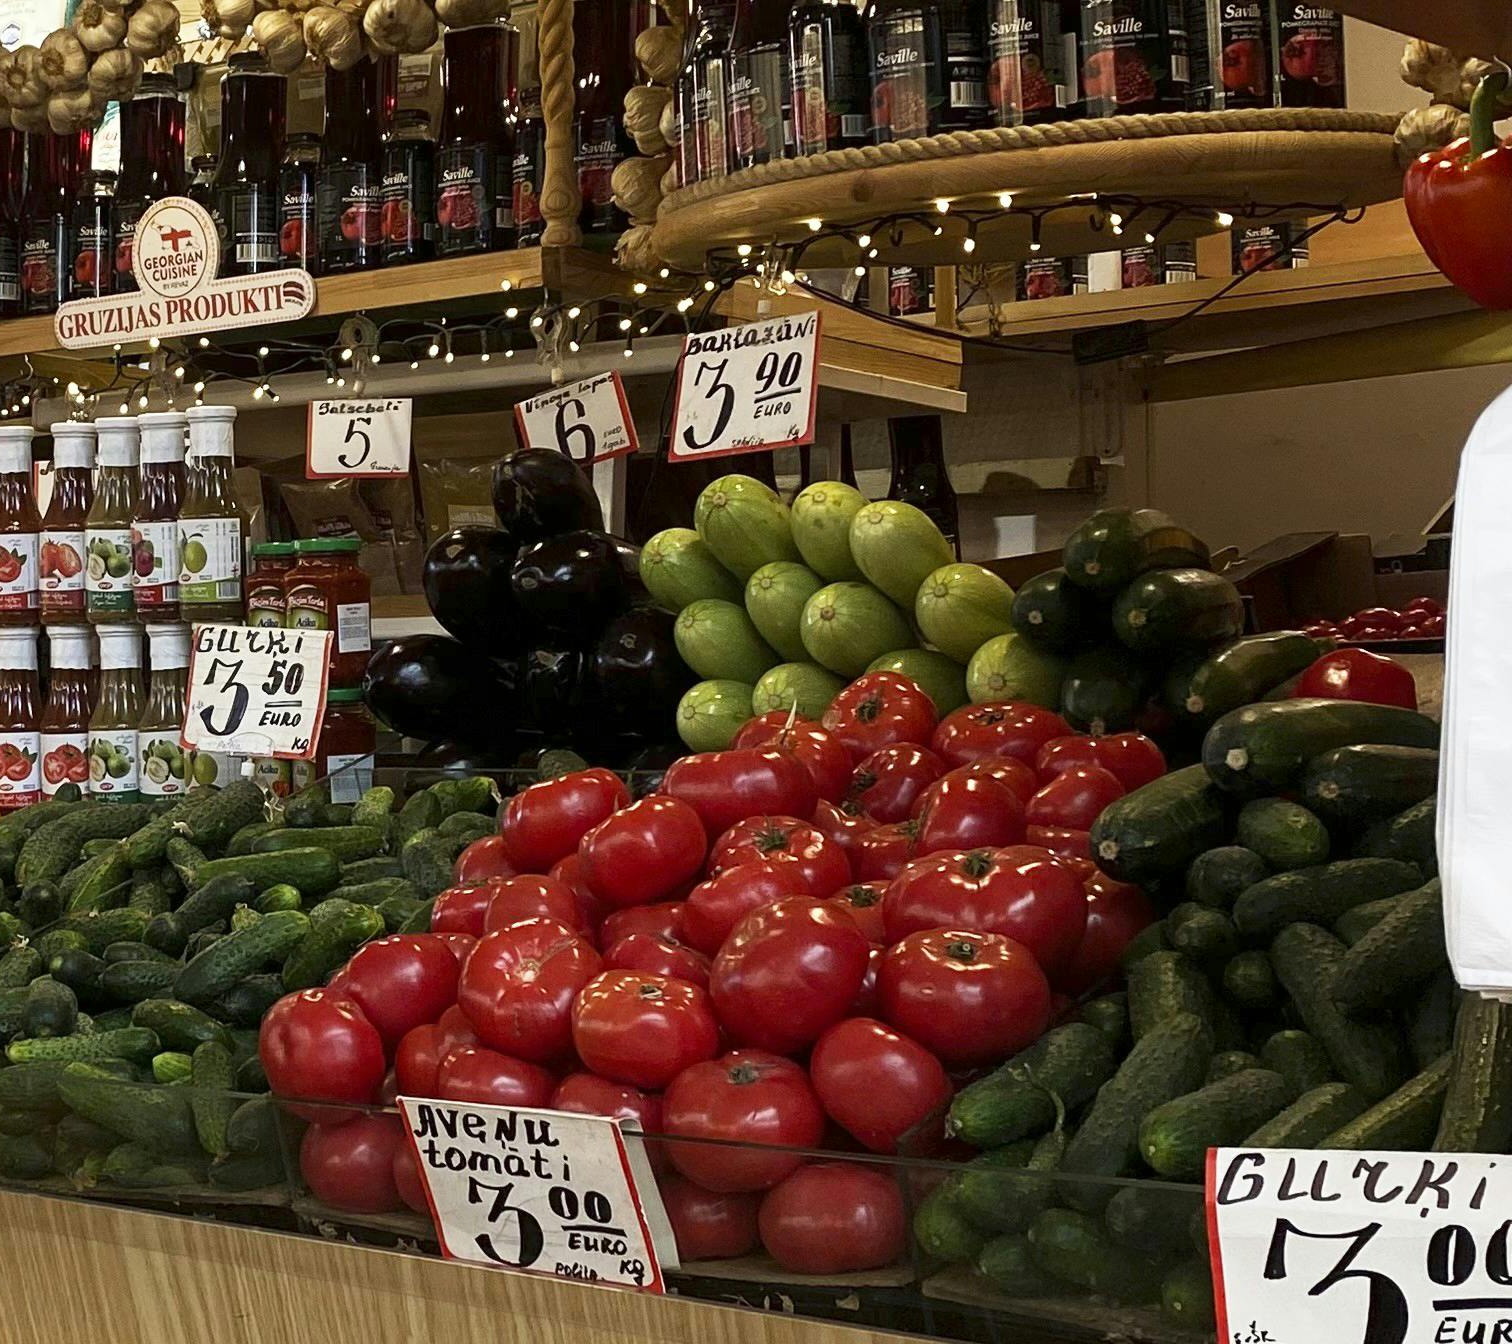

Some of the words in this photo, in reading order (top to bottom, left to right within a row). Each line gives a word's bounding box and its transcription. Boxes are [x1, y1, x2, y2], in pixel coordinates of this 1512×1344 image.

[989, 17, 1033, 37] Saville
[1092, 17, 1143, 38] Saville
[876, 48, 919, 68] Saville
[581, 140, 617, 155] Saville
[382, 172, 409, 186] Saville
[442, 166, 474, 182] Saville
[284, 193, 314, 205] Saville
[79, 225, 109, 237] Saville
[24, 239, 50, 251] Saville
[143, 250, 204, 271] GEORGIAN
[152, 263, 198, 282] CUISINE
[58, 301, 161, 340] GRUZIJAS
[164, 283, 283, 325] PRODUKTI
[754, 352, 803, 395] 90
[683, 358, 735, 450] 3
[753, 401, 792, 420] EURO
[555, 398, 596, 460] 6
[338, 417, 371, 468] 5
[261, 659, 305, 695] 50
[200, 658, 250, 736] 3
[258, 709, 302, 727] EURO
[422, 1140, 571, 1182] tomāti
[548, 1185, 612, 1224] 00
[468, 1175, 544, 1269] 3
[567, 1232, 628, 1256] EURO
